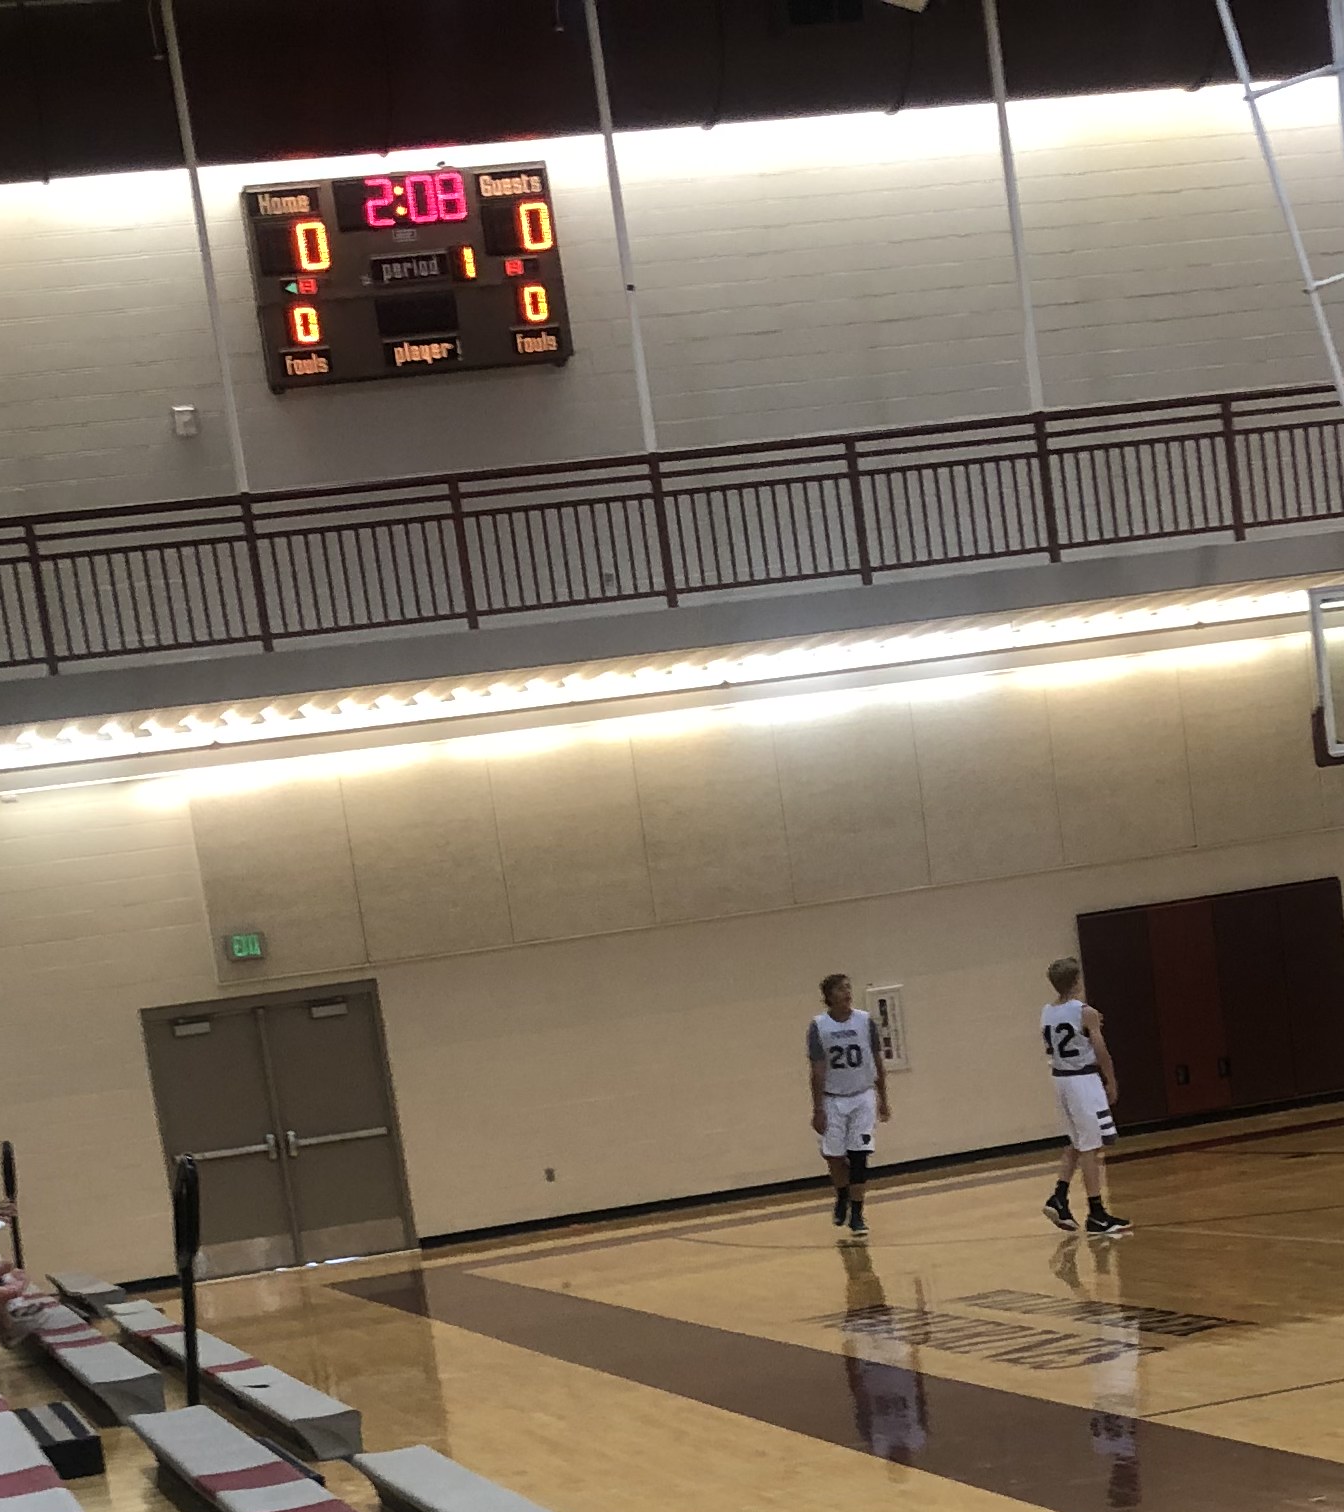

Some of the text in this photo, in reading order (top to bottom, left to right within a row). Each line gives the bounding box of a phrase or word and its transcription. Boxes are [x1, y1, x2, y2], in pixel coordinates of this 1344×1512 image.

[364, 172, 468, 227] 2:08
[479, 174, 543, 197] Guests
[257, 193, 310, 216] Home
[519, 202, 553, 250] 0
[296, 221, 331, 271] 0
[462, 246, 477, 278] 1
[381, 256, 440, 284] period
[523, 285, 549, 322] 0
[293, 307, 320, 342] 0
[394, 341, 454, 367] player
[829, 1043, 863, 1069] 20
